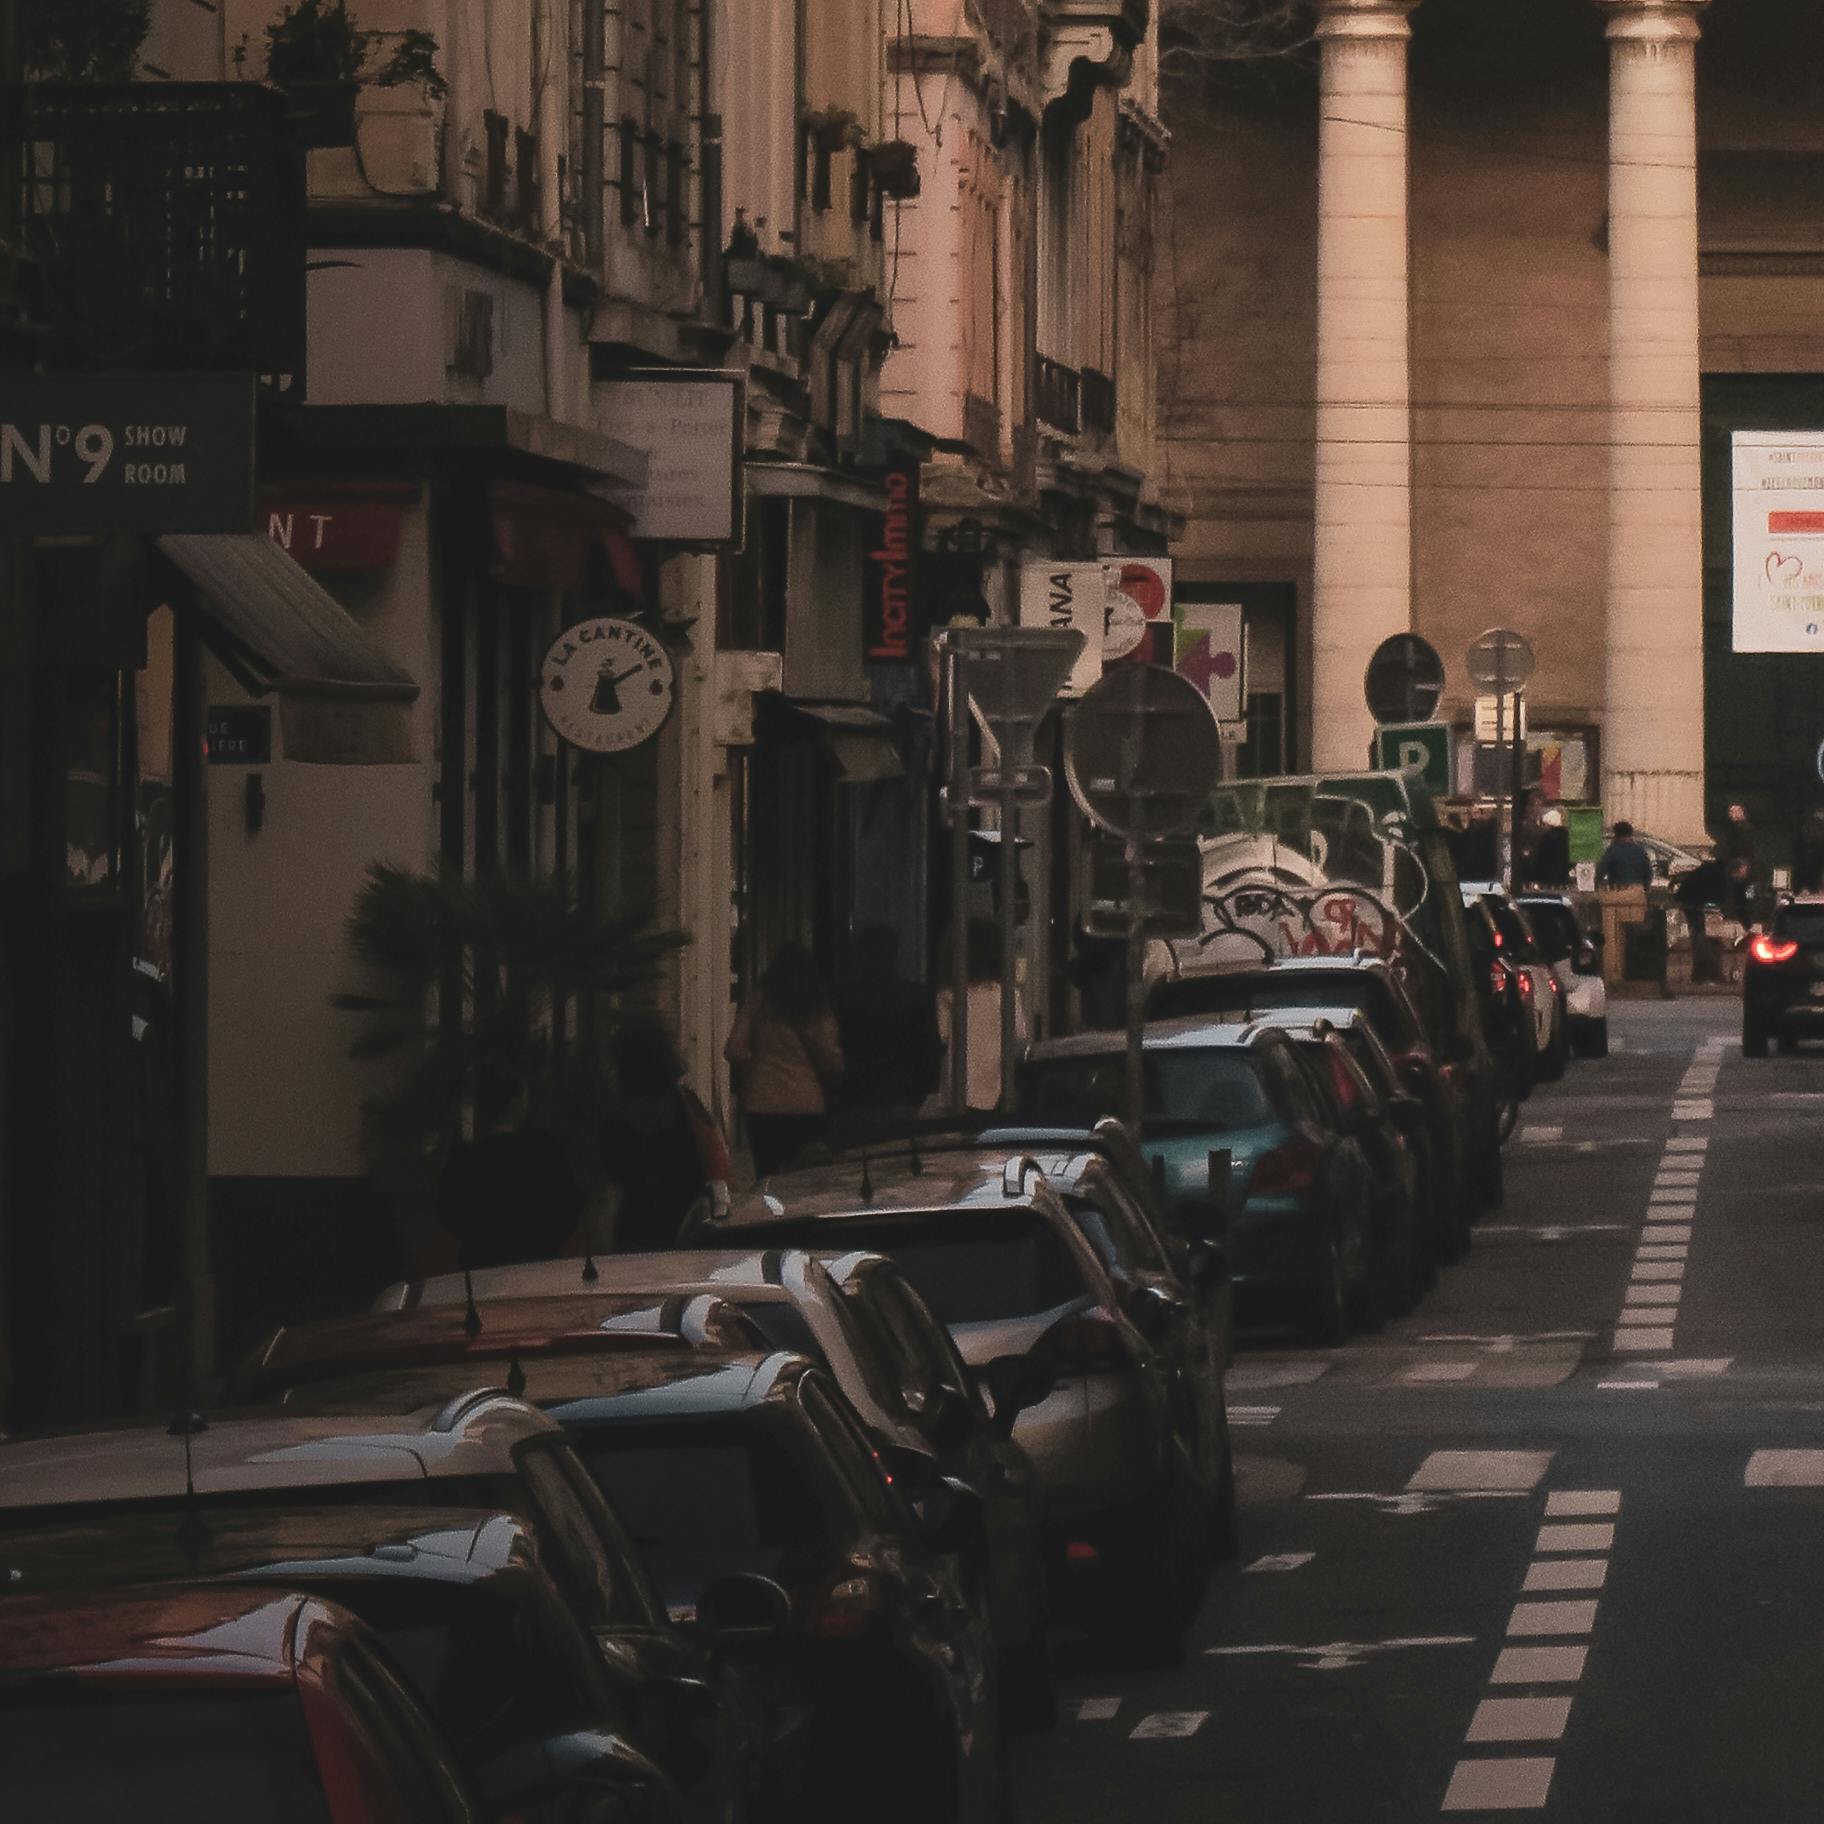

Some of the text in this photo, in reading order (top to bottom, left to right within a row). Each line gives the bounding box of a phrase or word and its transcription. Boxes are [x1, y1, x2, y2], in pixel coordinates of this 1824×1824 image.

[124, 425, 187, 447] SHOW
[124, 463, 187, 485] ROOM
[551, 626, 663, 670] LA CANTINE
